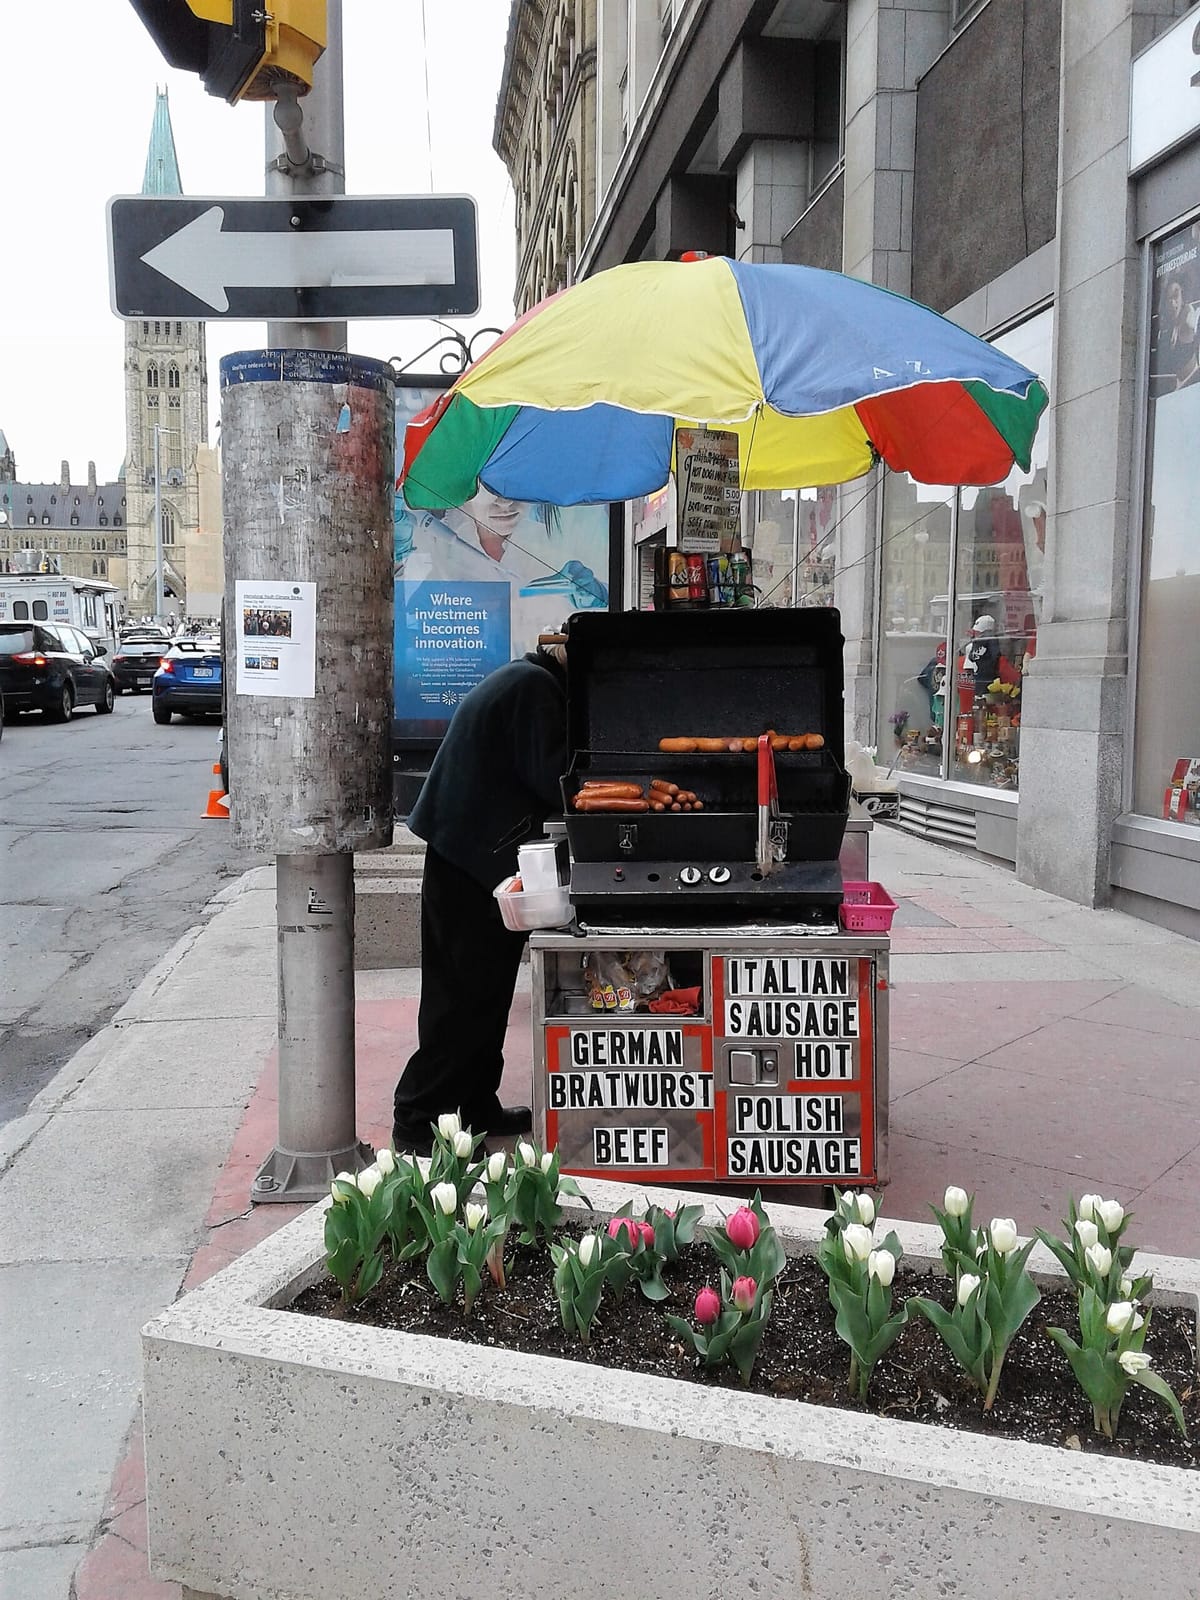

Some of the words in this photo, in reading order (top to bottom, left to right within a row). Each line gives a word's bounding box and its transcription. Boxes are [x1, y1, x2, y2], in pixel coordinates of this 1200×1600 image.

[725, 489, 740, 500] 5.00
[415, 608, 488, 620] investment
[430, 592, 472, 606] Where
[415, 636, 487, 649] innovation.
[422, 622, 480, 635] becomes
[730, 960, 848, 995] ITALIAN
[730, 1001, 858, 1036] SAUSAGE
[573, 1031, 682, 1065] GERMAN
[795, 1043, 851, 1078] HOT
[551, 1072, 714, 1108] BRATWURST
[737, 1096, 842, 1132] POLISH
[595, 1129, 667, 1164] BEEF
[730, 1138, 859, 1174] SAUSAGE
